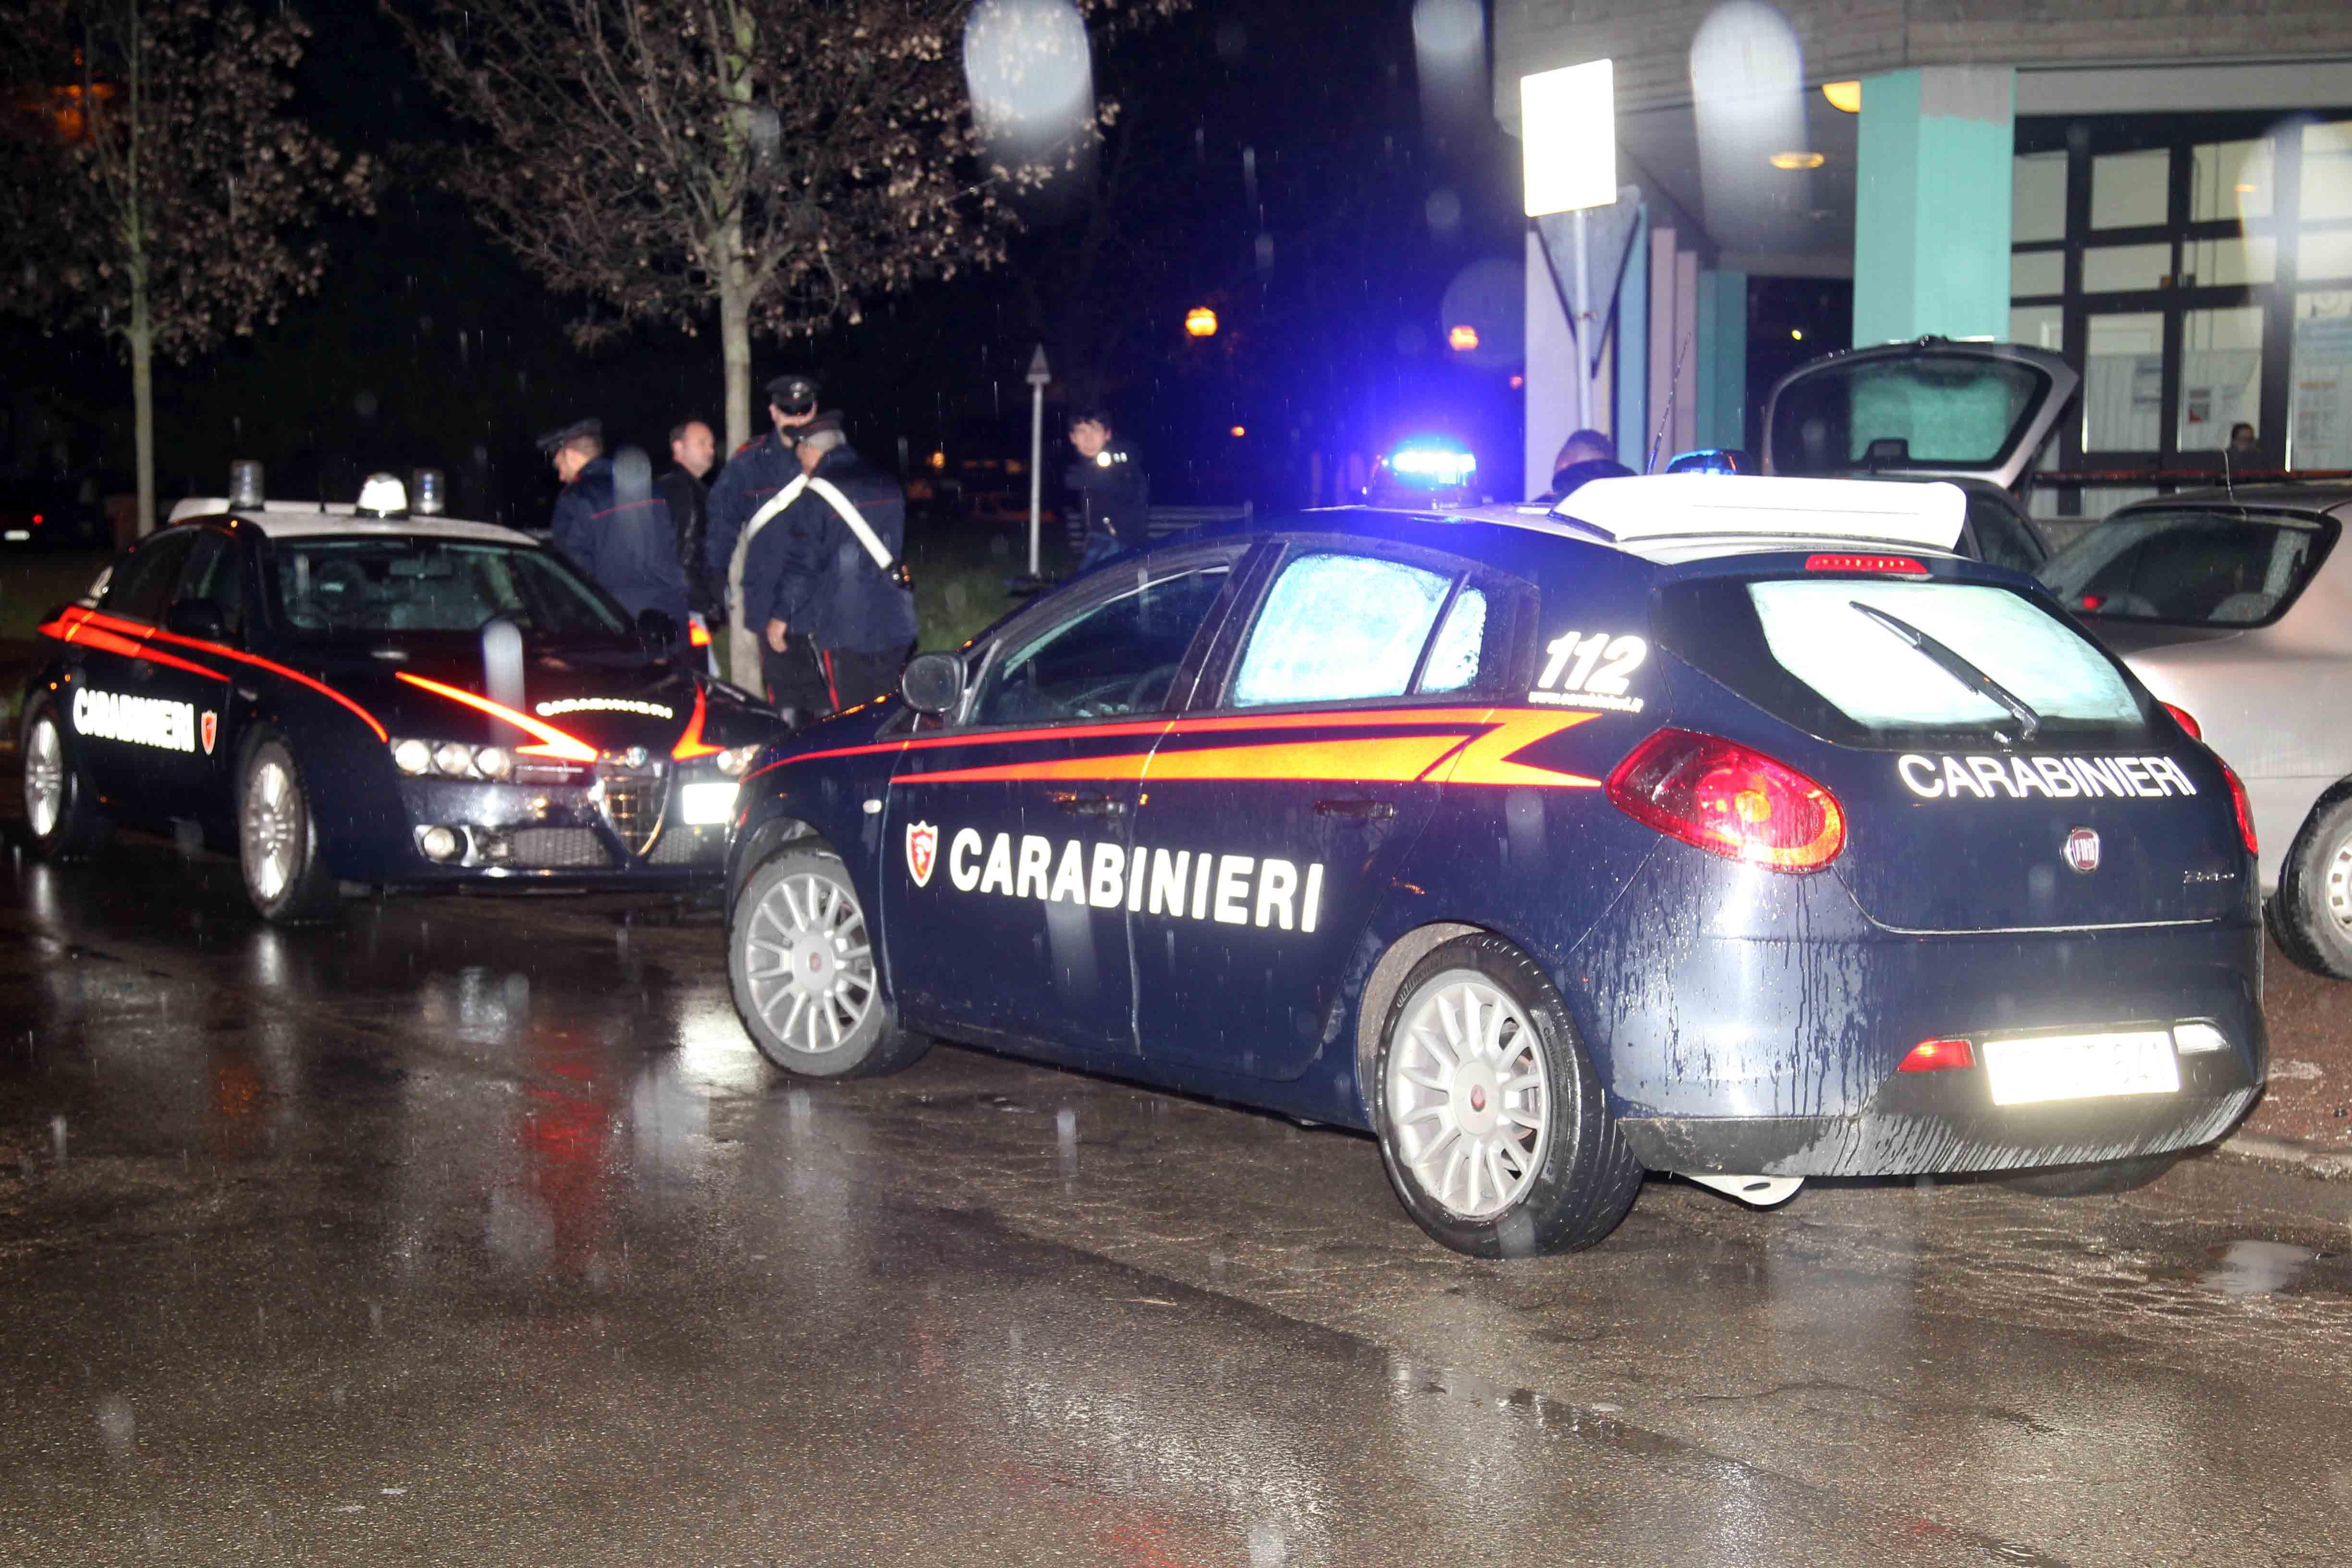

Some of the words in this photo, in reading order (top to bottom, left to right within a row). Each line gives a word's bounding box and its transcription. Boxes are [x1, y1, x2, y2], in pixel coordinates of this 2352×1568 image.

[1538, 631, 1647, 696] 112
[1898, 754, 2197, 798] CARABINIERI
[949, 827, 1324, 932] CARABINIERI
